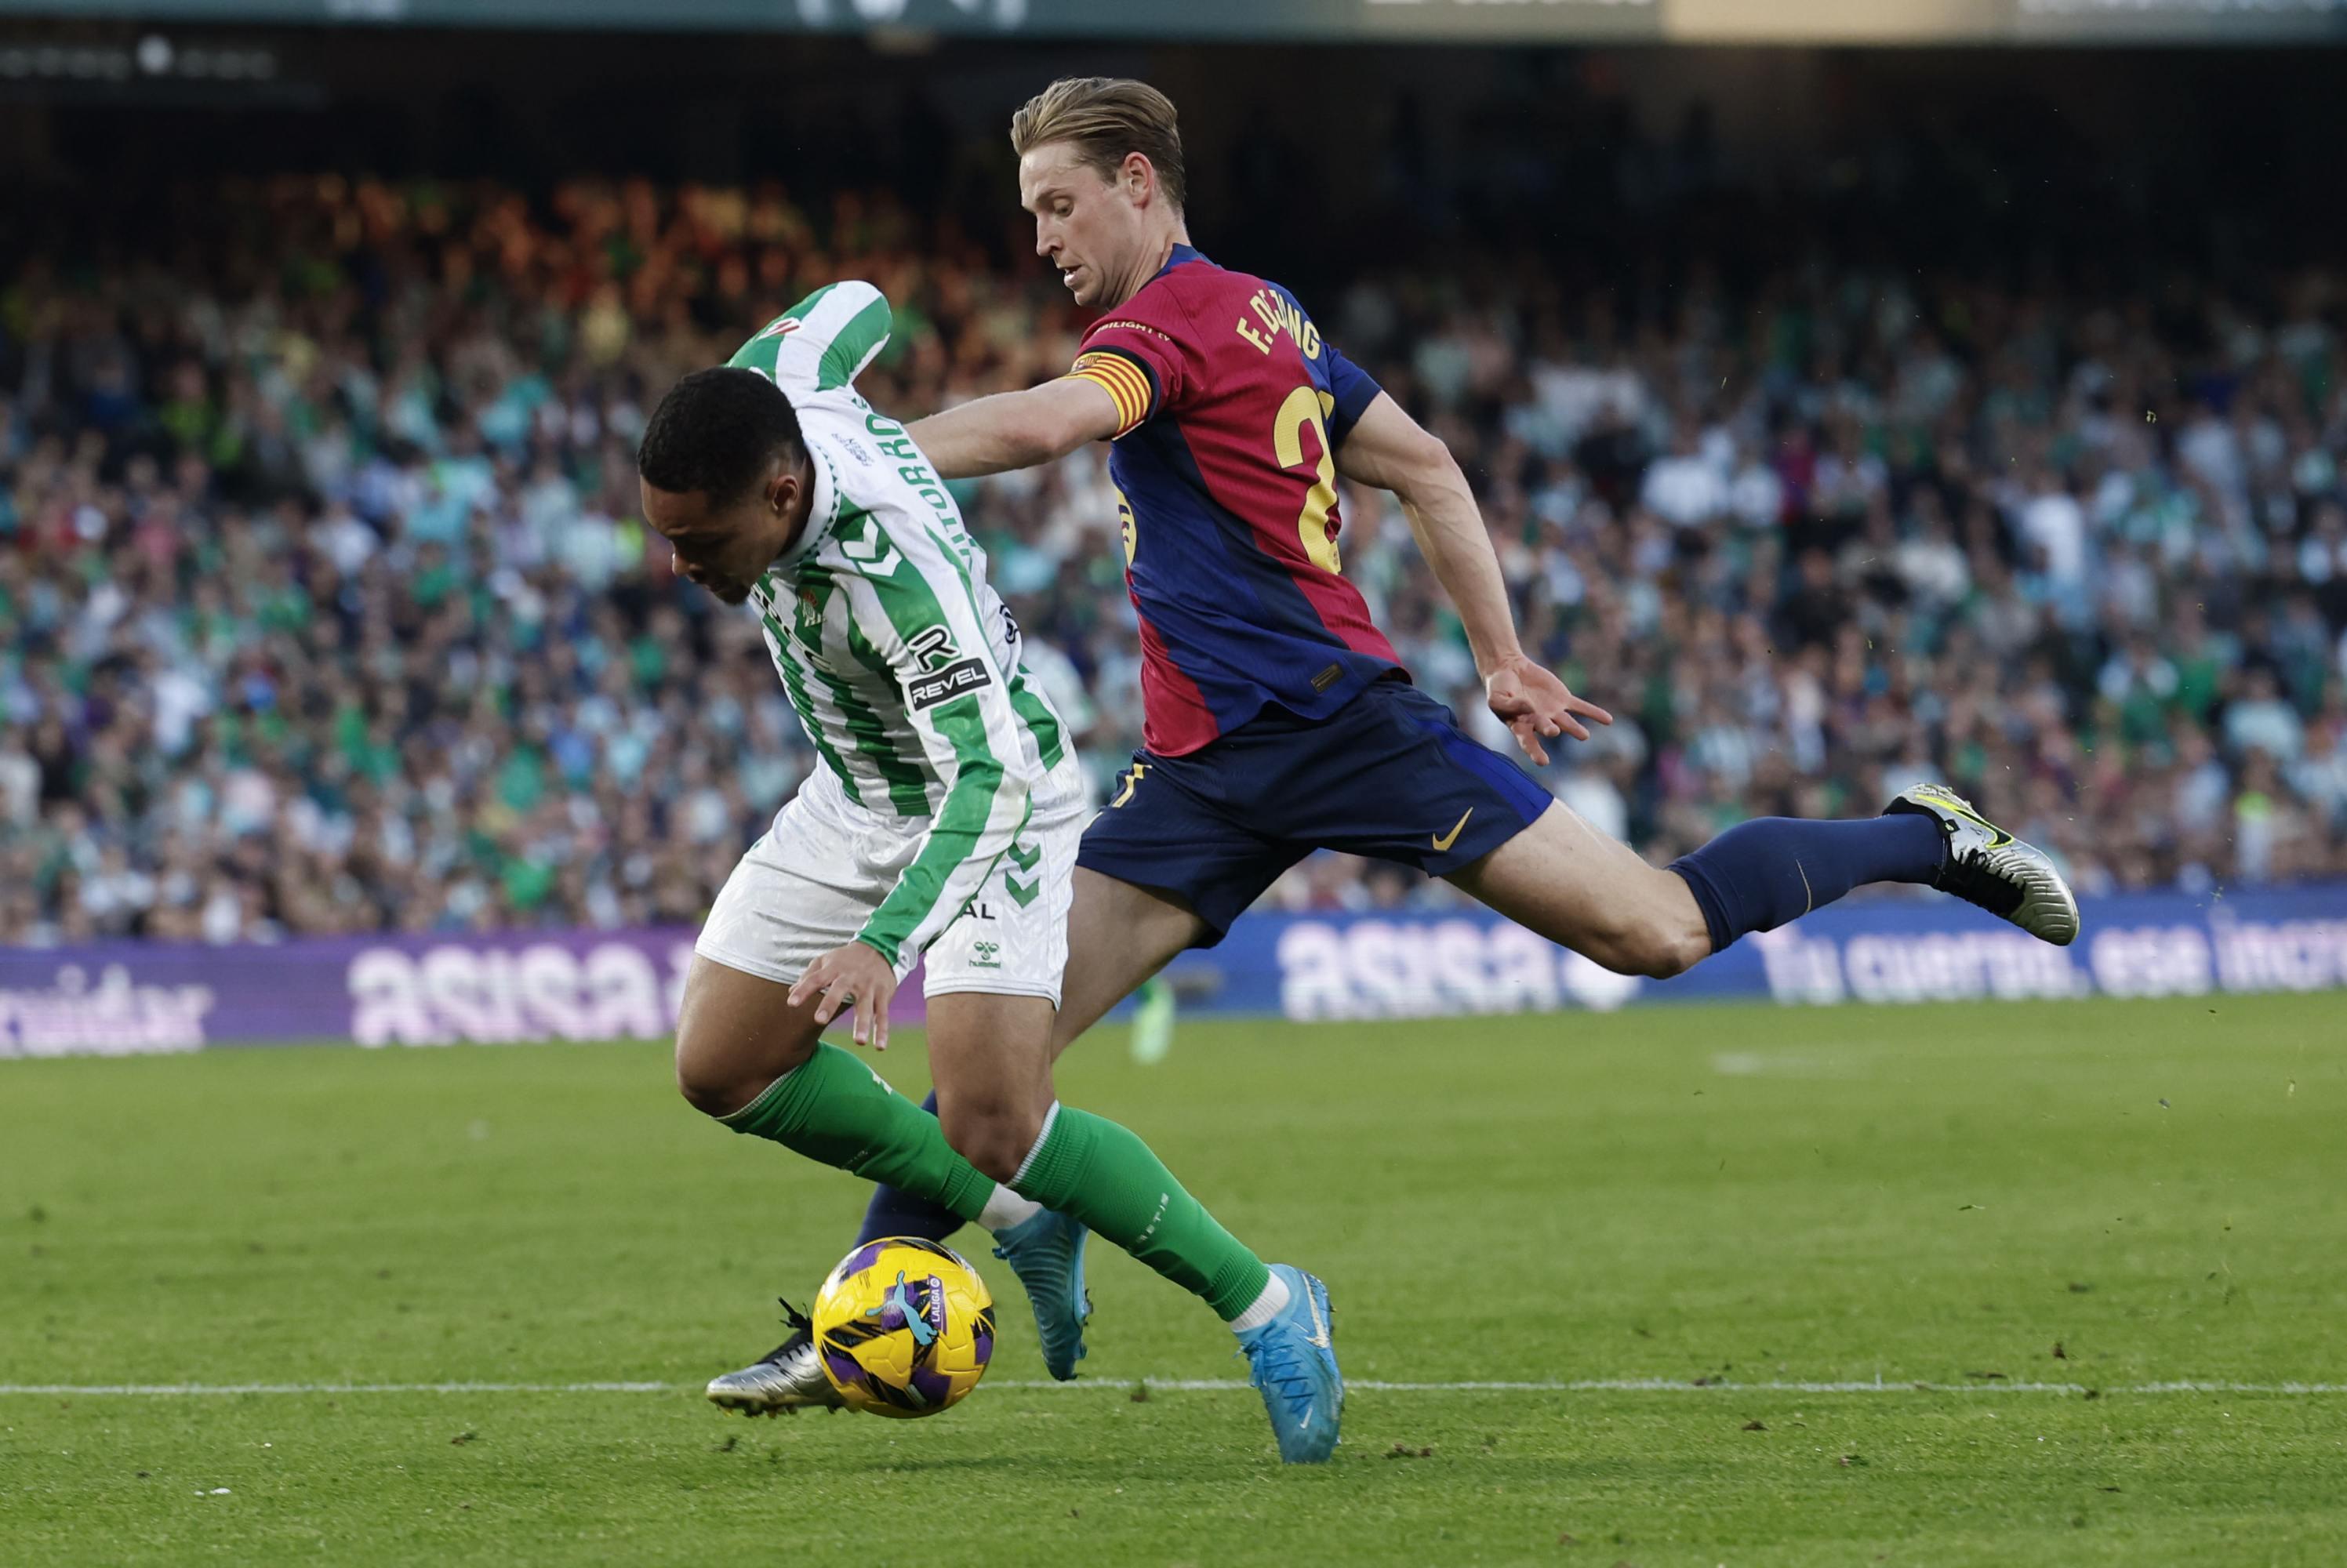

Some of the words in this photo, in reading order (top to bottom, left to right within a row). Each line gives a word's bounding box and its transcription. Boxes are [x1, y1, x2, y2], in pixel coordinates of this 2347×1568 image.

[912, 666, 987, 705] REVEL
[346, 943, 664, 1048] asisa
[931, 1289, 940, 1323] LALIGA
